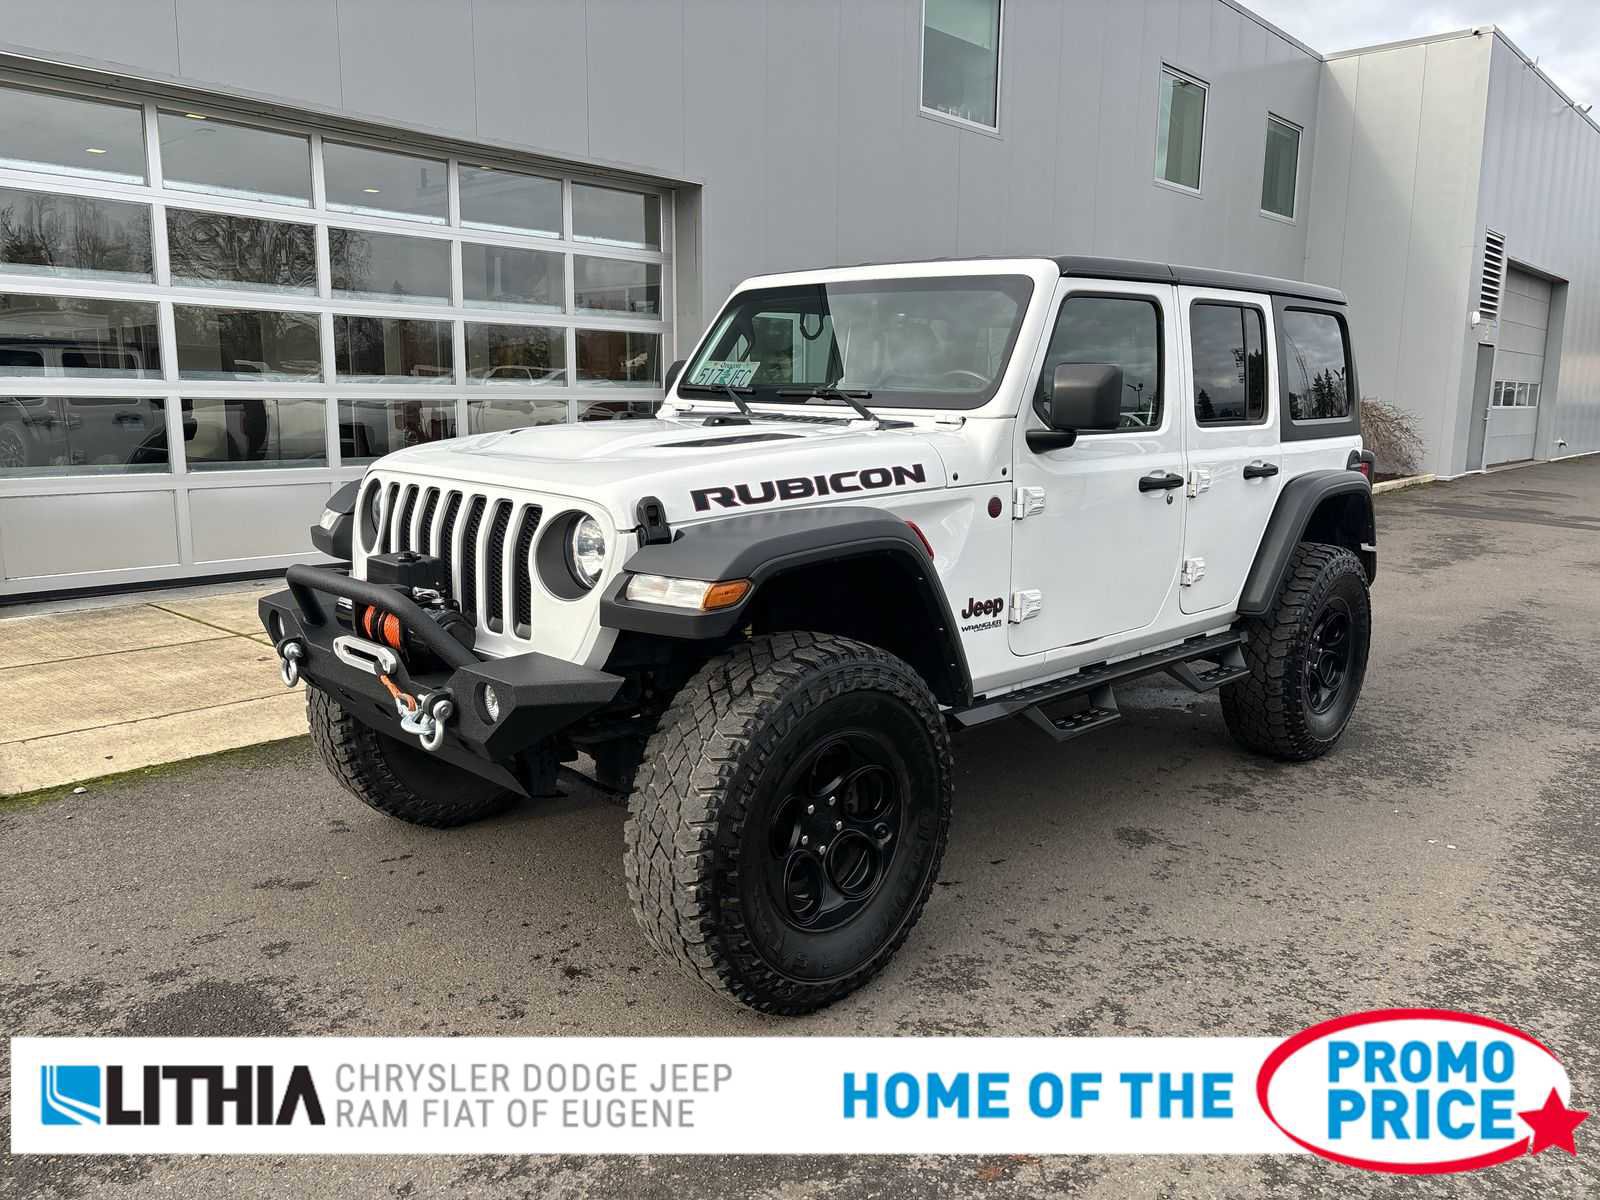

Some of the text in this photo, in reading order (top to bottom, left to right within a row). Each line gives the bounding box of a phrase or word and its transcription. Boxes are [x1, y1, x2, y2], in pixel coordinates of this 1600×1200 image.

[689, 463, 927, 512] RUBICON
[961, 597, 1004, 619] Jeep
[961, 619, 1002, 632] WRANGLER
